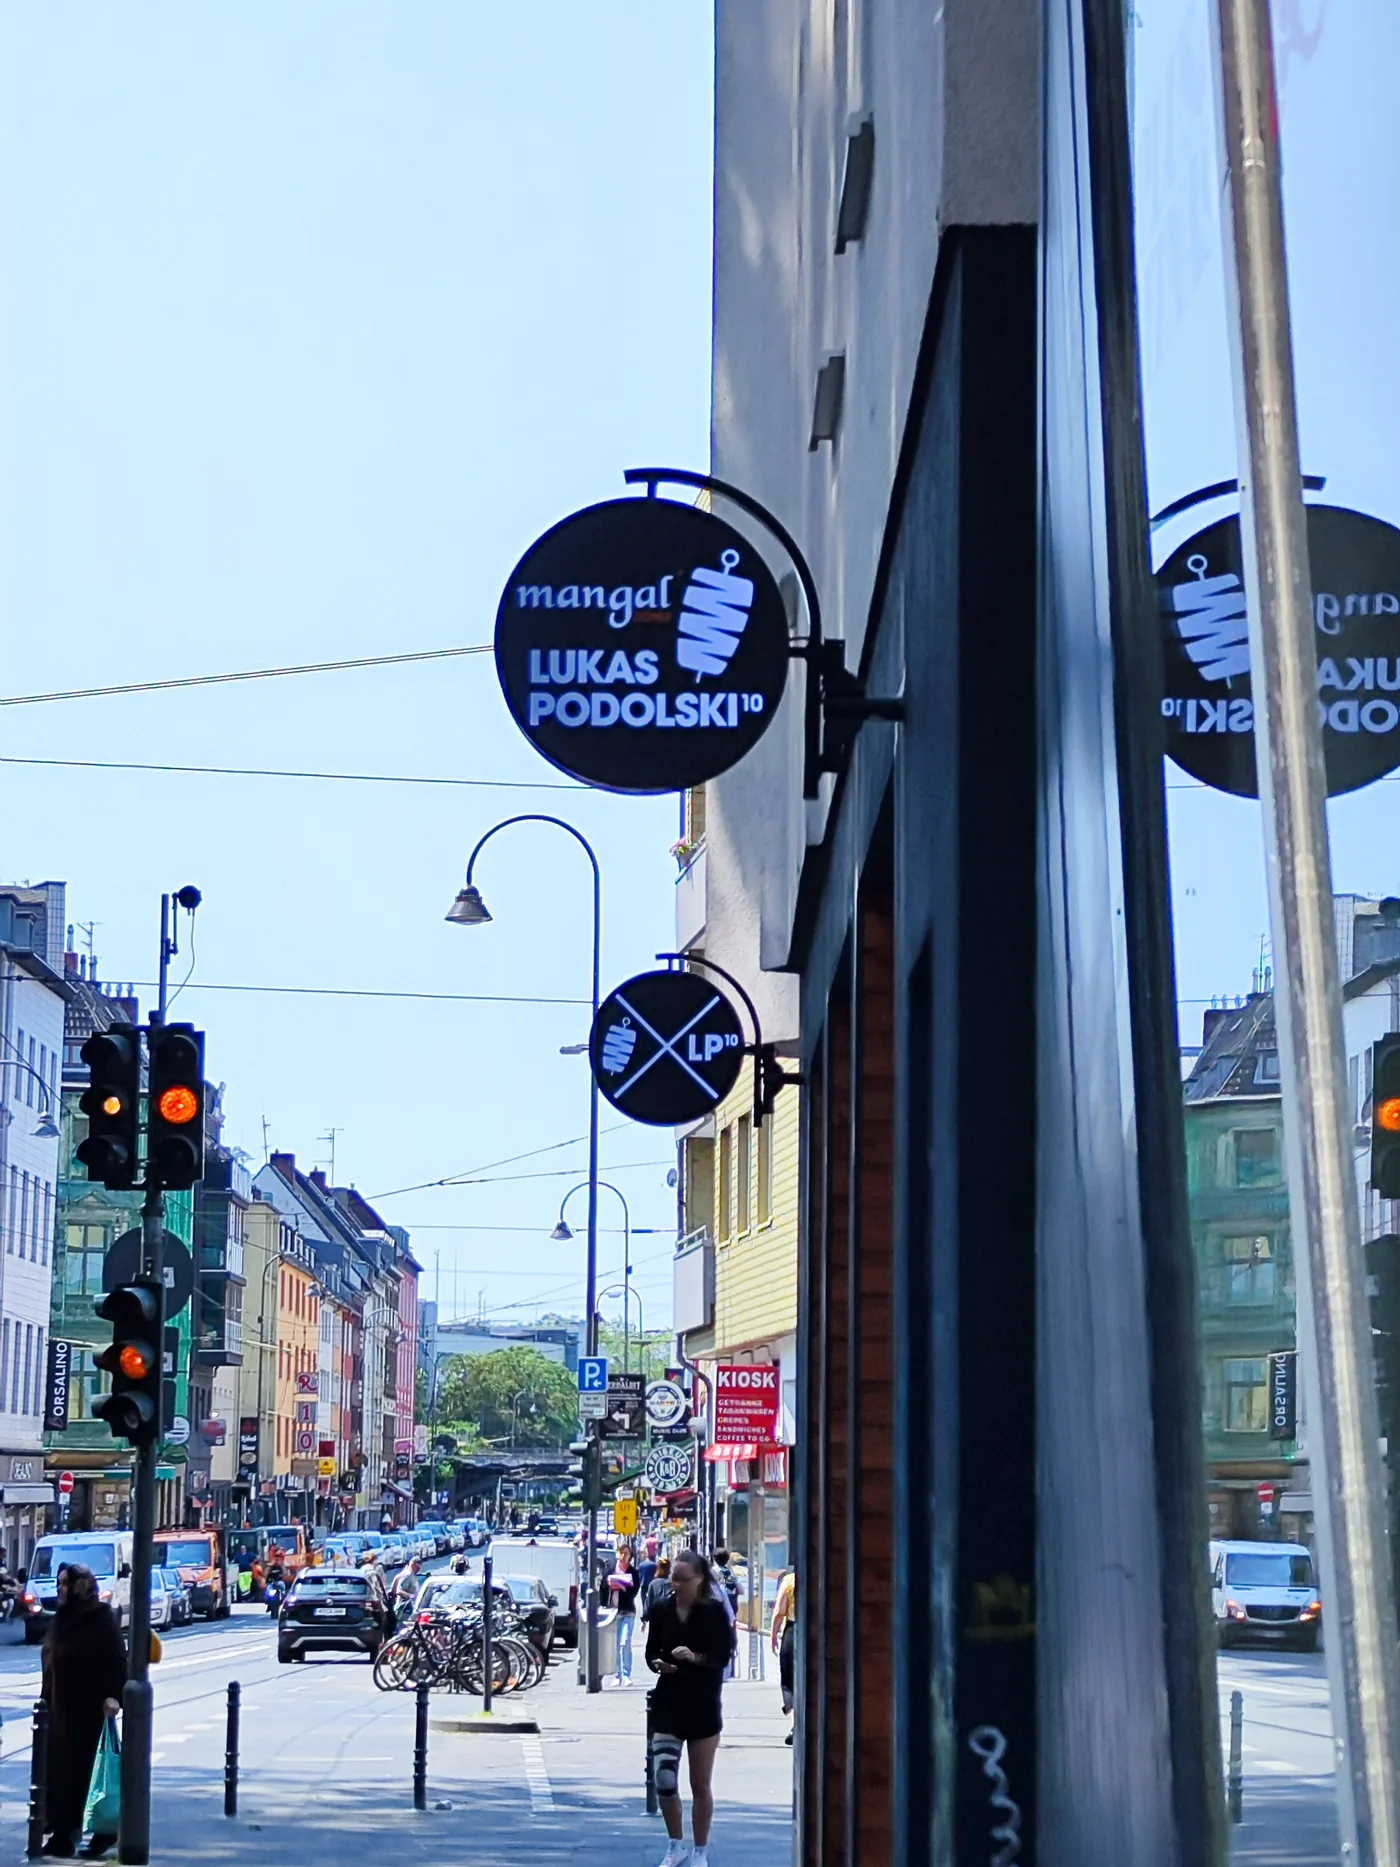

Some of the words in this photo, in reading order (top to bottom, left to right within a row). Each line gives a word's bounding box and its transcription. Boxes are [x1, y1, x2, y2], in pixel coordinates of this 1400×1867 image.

[516, 575, 674, 629] mangal
[529, 649, 659, 684] LUKAS
[585, 1362, 600, 1388] P
[718, 1371, 775, 1388] KIOSK
